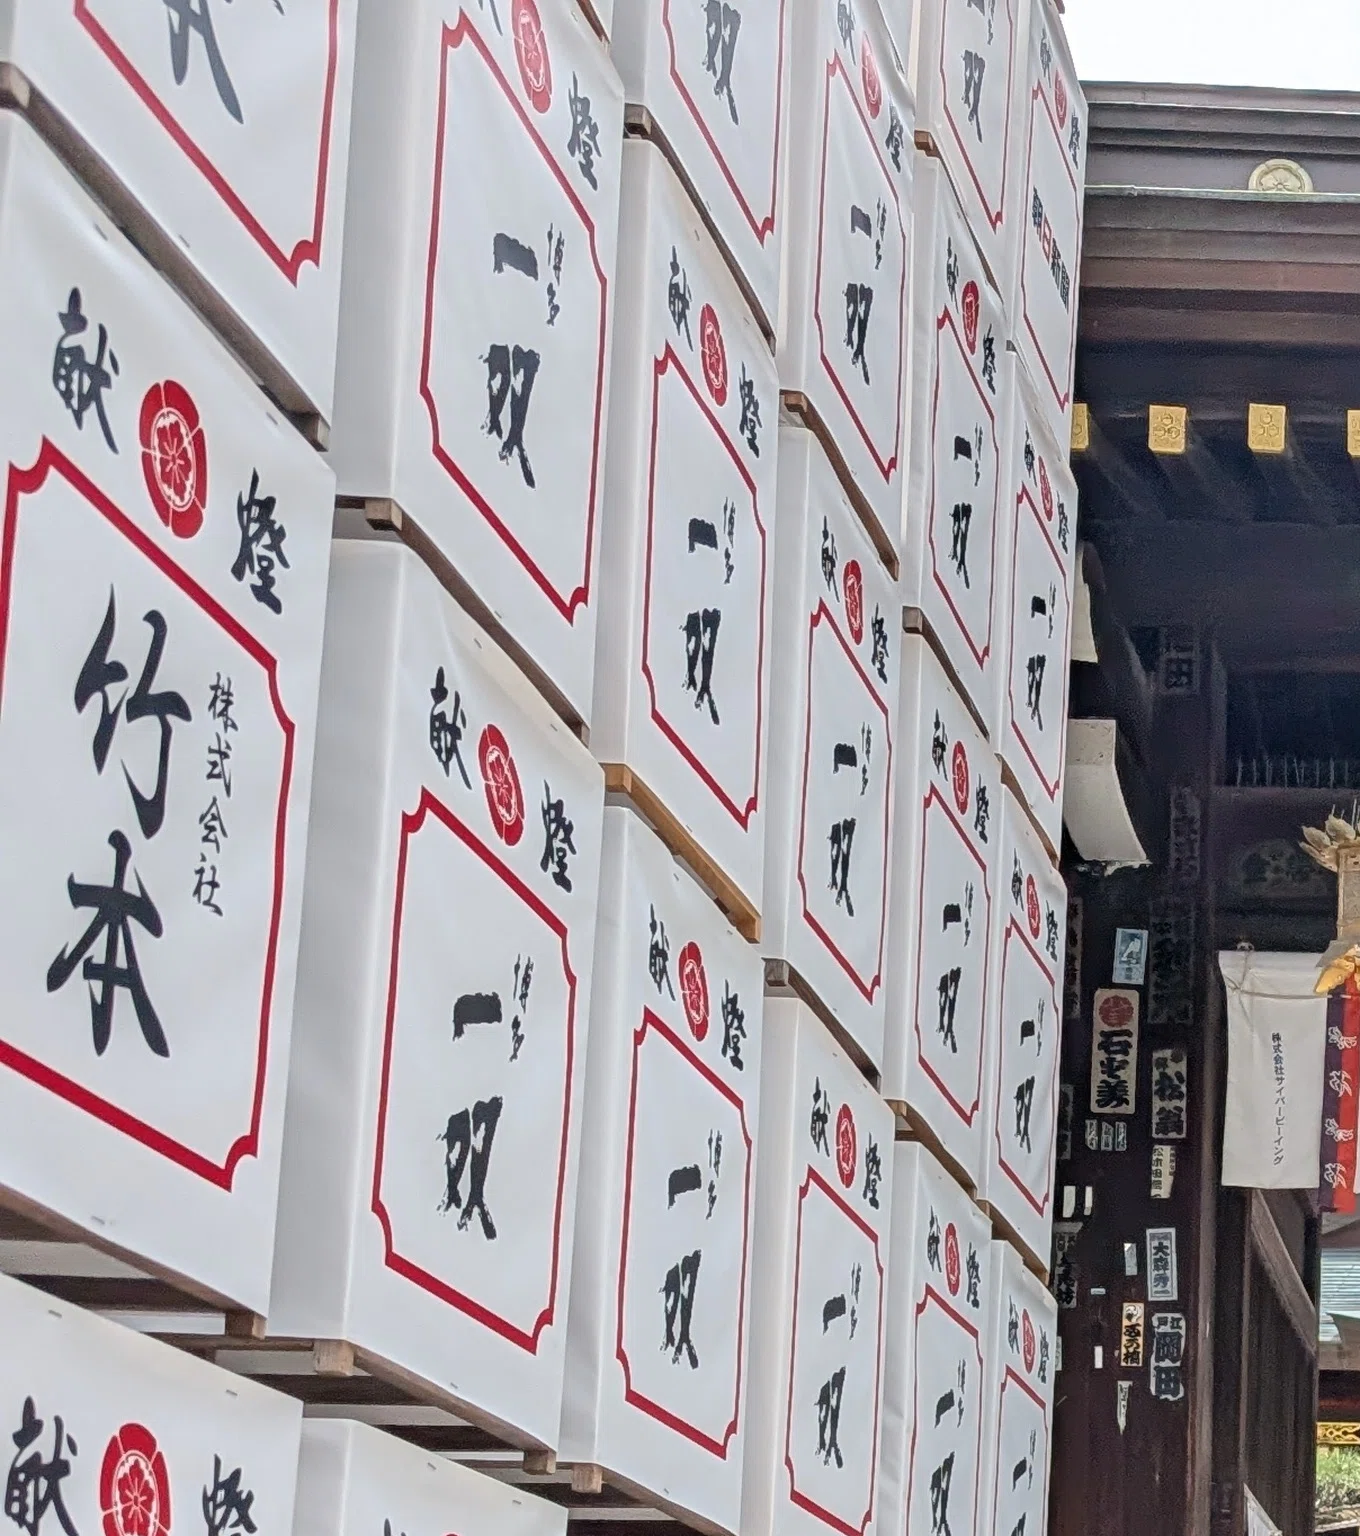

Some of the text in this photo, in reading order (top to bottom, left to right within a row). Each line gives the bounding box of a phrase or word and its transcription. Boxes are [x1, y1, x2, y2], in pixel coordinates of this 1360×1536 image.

[52, 287, 119, 454] 献
[479, 233, 540, 488] 一双
[669, 246, 693, 351] 献
[679, 518, 721, 725] 一双
[47, 584, 192, 1058] 竹本
[193, 672, 238, 916] 株式会社
[430, 666, 472, 790] 献
[649, 904, 675, 1001] 献
[436, 992, 503, 1240] 一双
[1271, 1032, 1286, 1165] 株式会社サイバービーイング
[660, 1164, 702, 1369] 一双
